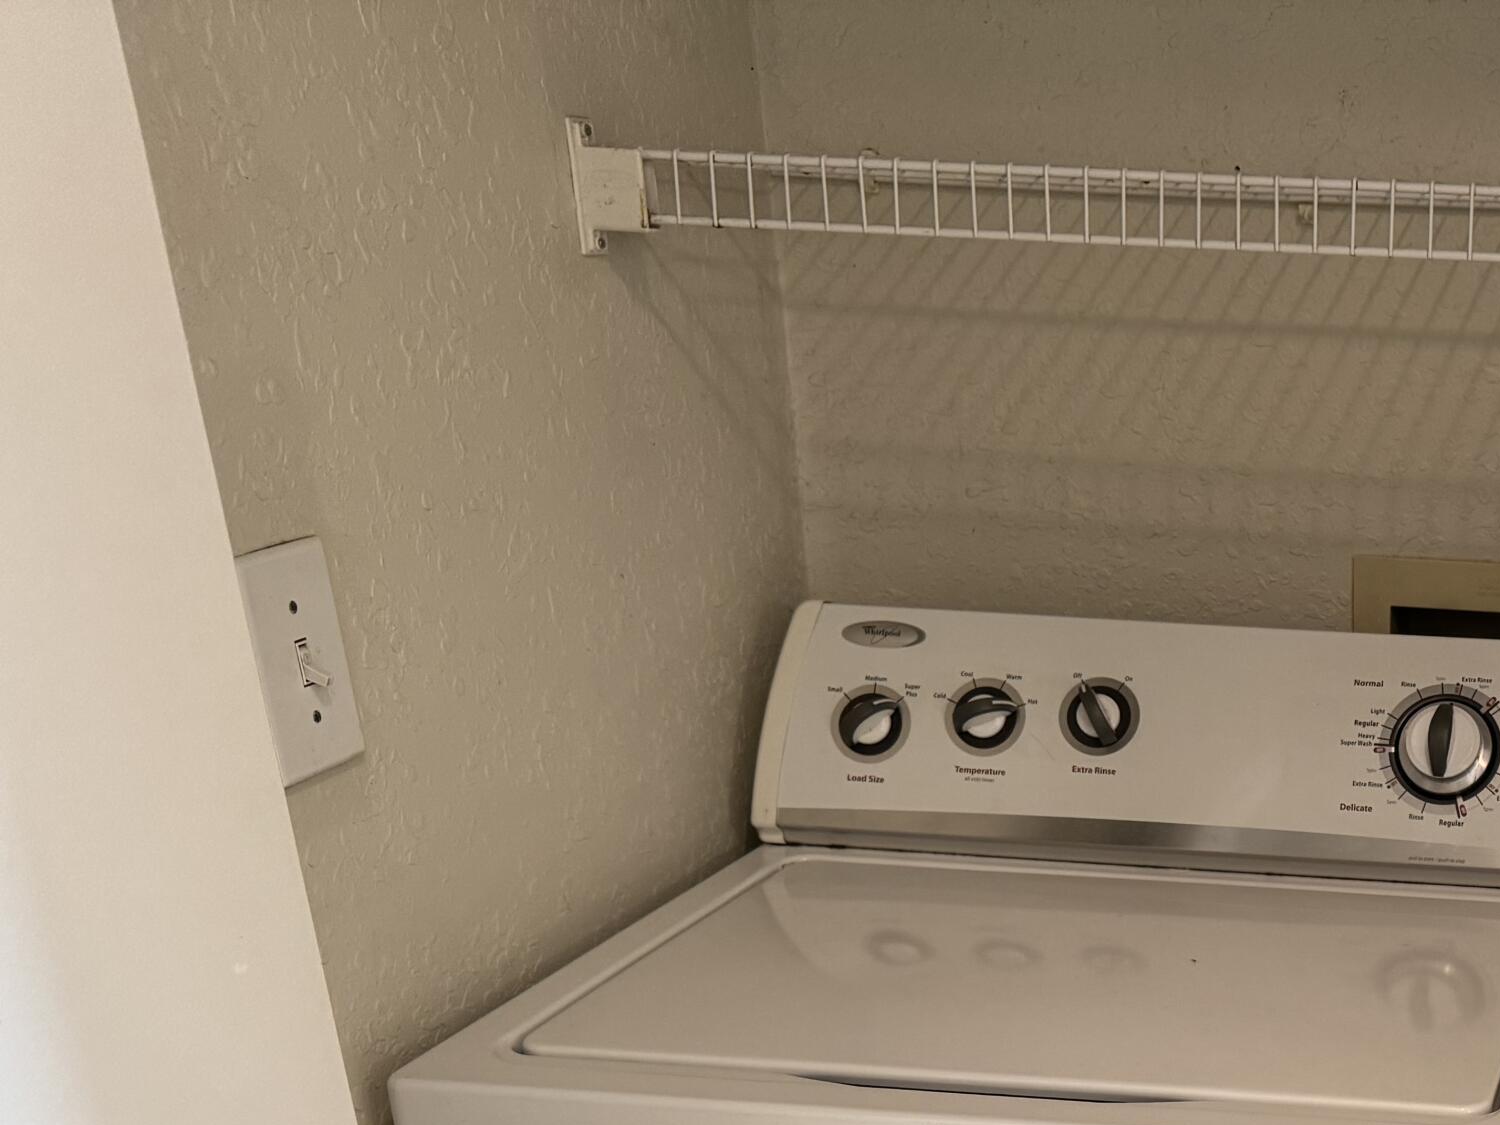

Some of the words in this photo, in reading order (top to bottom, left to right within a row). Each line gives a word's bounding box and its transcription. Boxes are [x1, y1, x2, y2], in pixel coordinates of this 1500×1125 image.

[1354, 679, 1384, 688] Normal
[1354, 720, 1380, 729] Regular
[1358, 733, 1376, 741] Heavy
[954, 766, 1006, 777] Temperature
[1072, 765, 1093, 774] Extra
[1094, 766, 1116, 776] Rinse
[846, 774, 867, 783] Load
[868, 775, 884, 784] Size
[1340, 803, 1372, 812] Delicate
[1438, 819, 1464, 828] Regular
